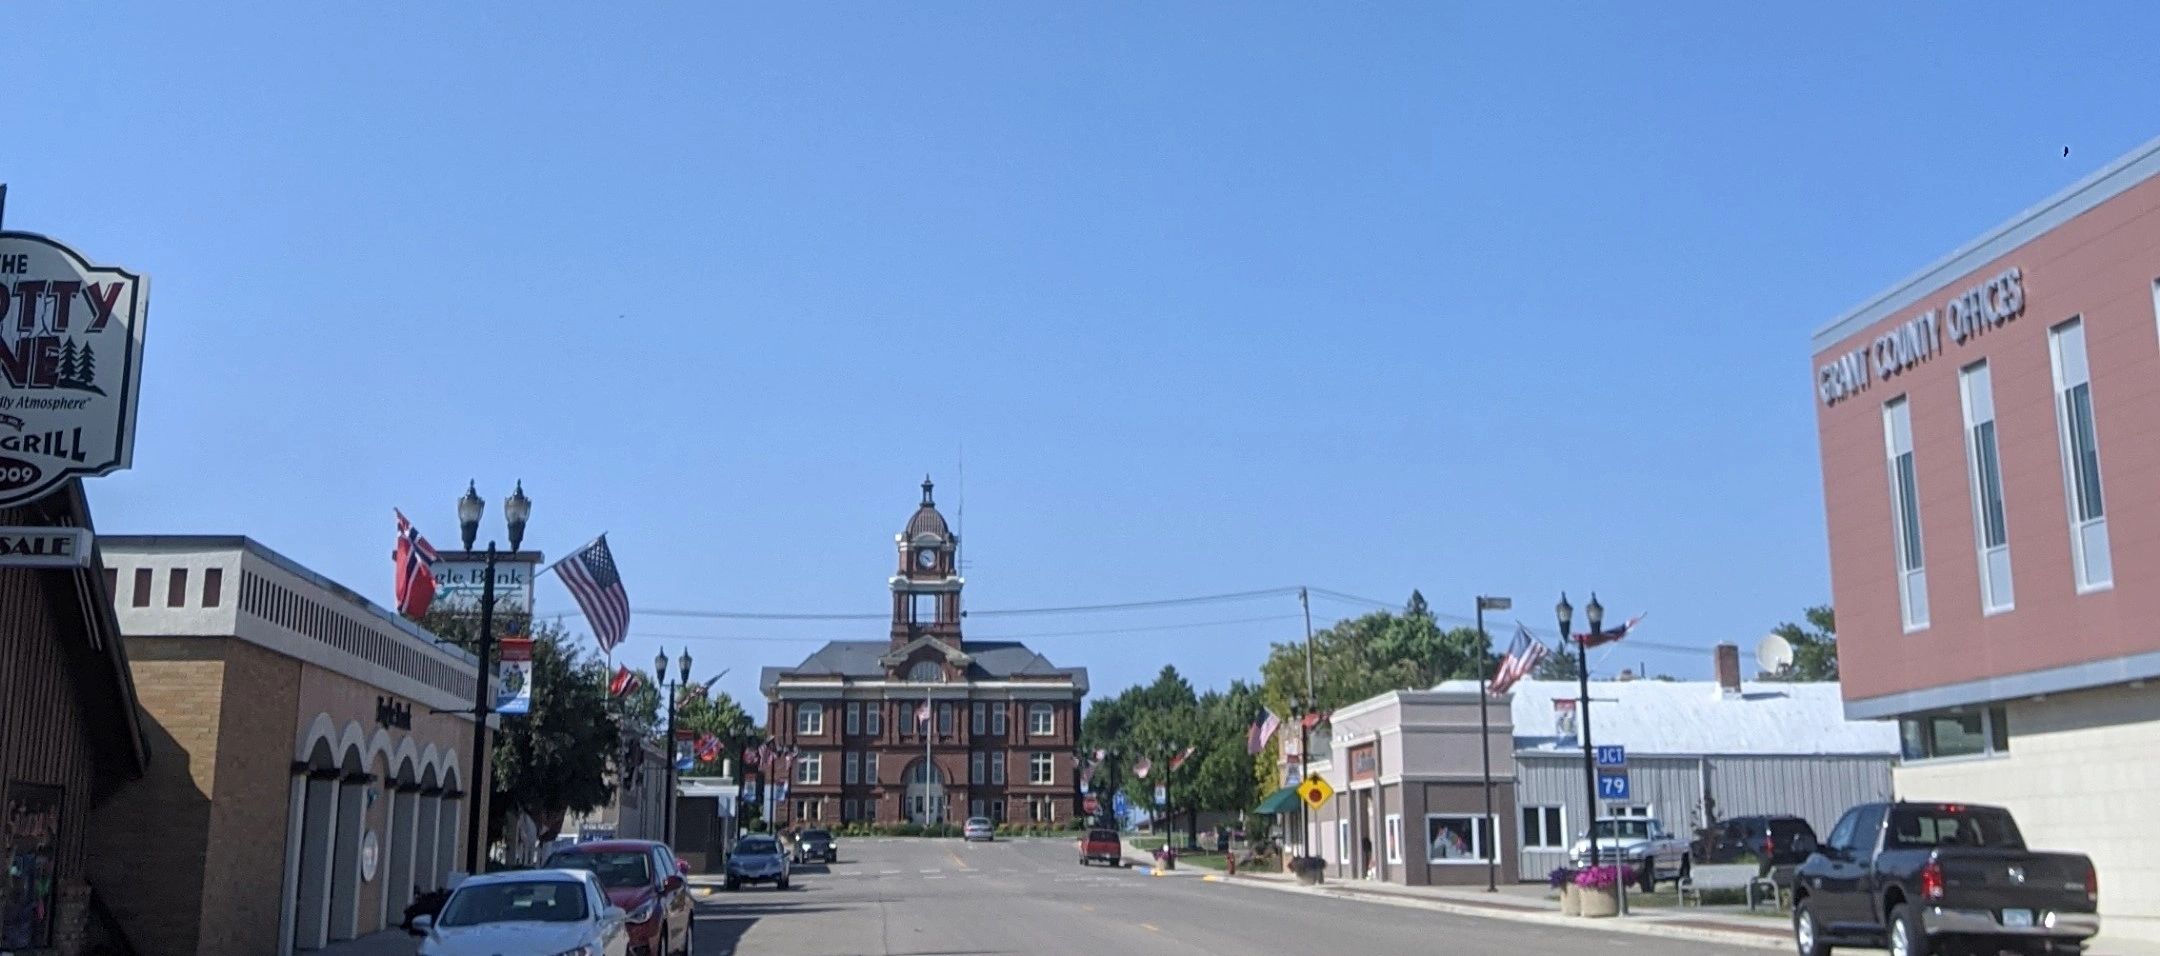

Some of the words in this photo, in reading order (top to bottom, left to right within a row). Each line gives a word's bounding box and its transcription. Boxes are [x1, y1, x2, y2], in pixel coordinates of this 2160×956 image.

[0, 254, 28, 274] HE
[1818, 348, 1871, 406] GRANT
[1872, 308, 1943, 381] COUNTY
[1946, 266, 2027, 346] OFFICES
[0, 427, 87, 463] GRILL
[0, 537, 72, 556] SALE
[471, 567, 523, 585] Bnk
[1600, 748, 1623, 764] JCT
[1602, 777, 1625, 795] 79
